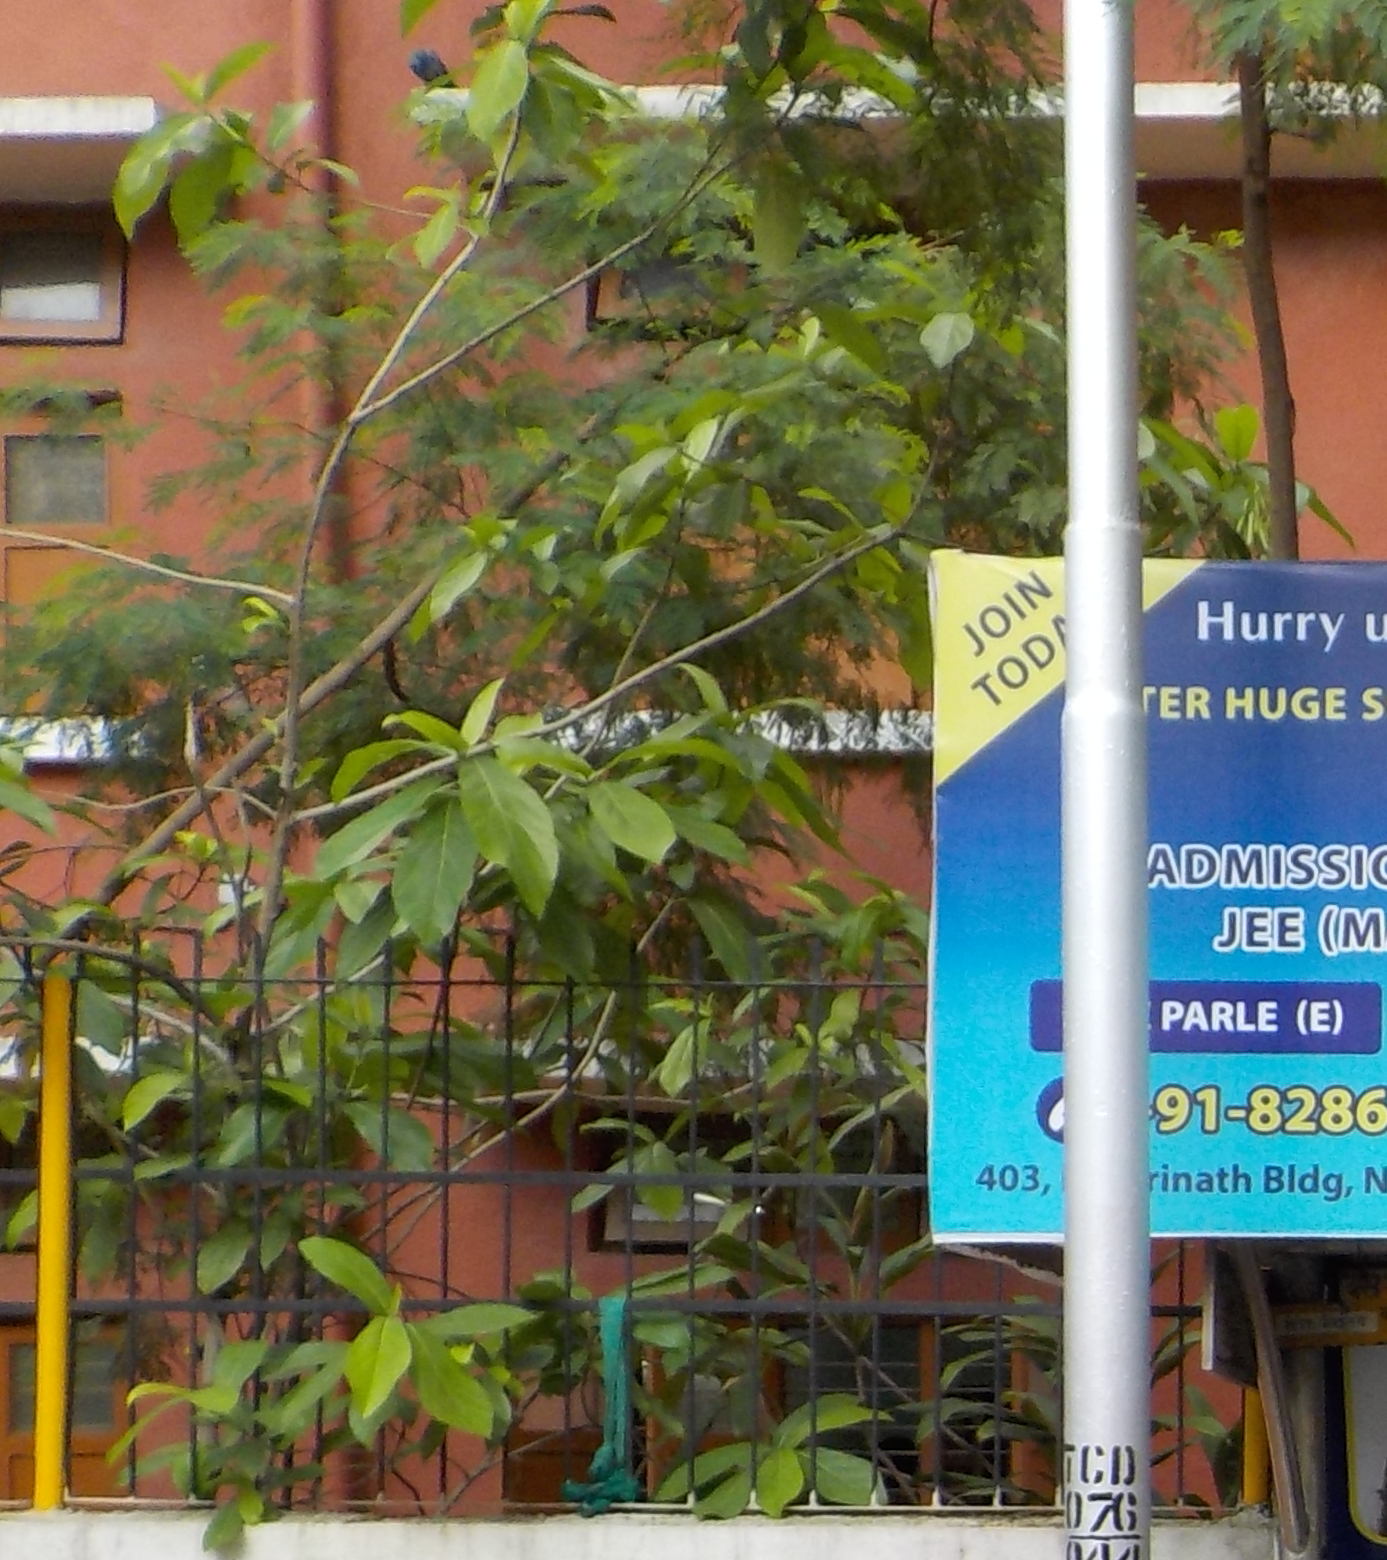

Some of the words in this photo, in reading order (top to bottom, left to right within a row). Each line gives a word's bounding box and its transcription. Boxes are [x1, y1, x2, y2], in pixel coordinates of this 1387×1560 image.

[962, 570, 1053, 657] JOIN
[1197, 601, 1345, 651] Hurry
[970, 614, 1066, 706] TOD
[1142, 686, 1211, 721] TER
[1226, 687, 1347, 721] HUGE
[1212, 905, 1305, 953] JEE
[1160, 1000, 1278, 1033] PARLE
[1296, 1000, 1345, 1037] (E)
[976, 1165, 1052, 1197] 403,
[1264, 1165, 1353, 1201] Bldg,
[1067, 1492, 1137, 1532] 076
